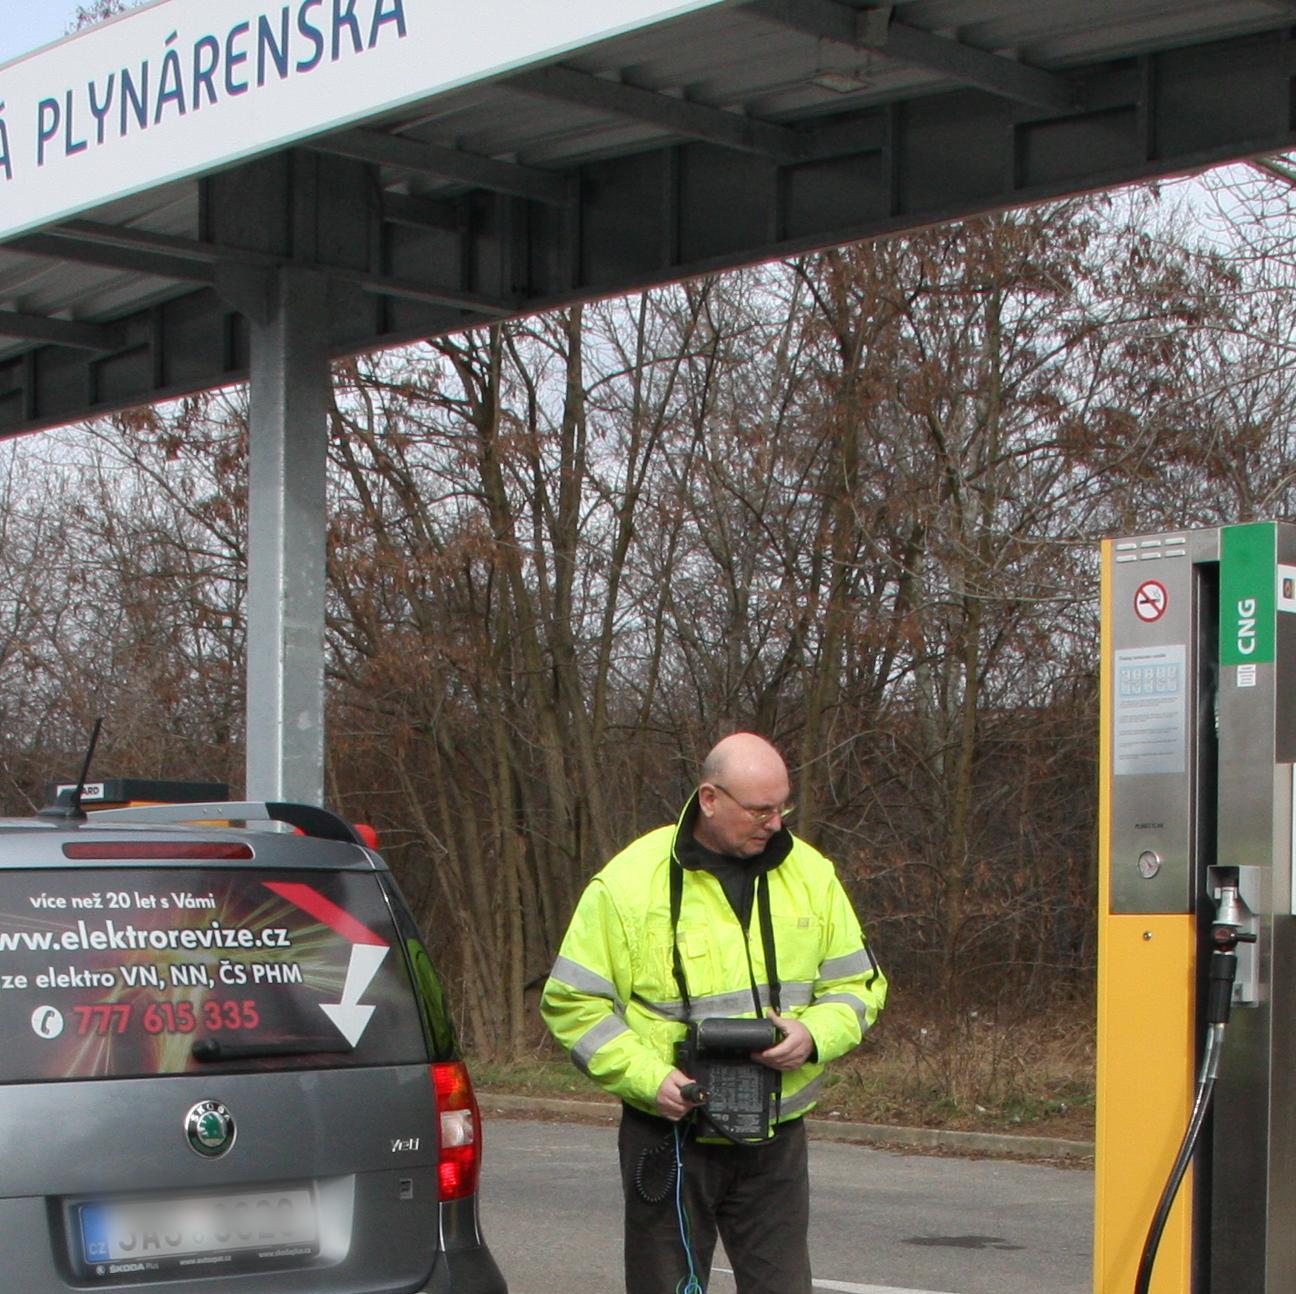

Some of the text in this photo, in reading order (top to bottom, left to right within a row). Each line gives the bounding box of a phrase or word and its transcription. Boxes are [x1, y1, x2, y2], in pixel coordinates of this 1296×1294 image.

[1237, 598, 1256, 655] CNG
[30, 892, 216, 909] více než 20 let s Vámi
[35, 966, 115, 988] elektro
[120, 966, 165, 989] VN,
[170, 965, 214, 989] NN,
[219, 960, 247, 985] ČS
[252, 964, 303, 985] PHM
[72, 1000, 260, 1036] 777 615 335
[390, 1138, 420, 1153] Yeti
